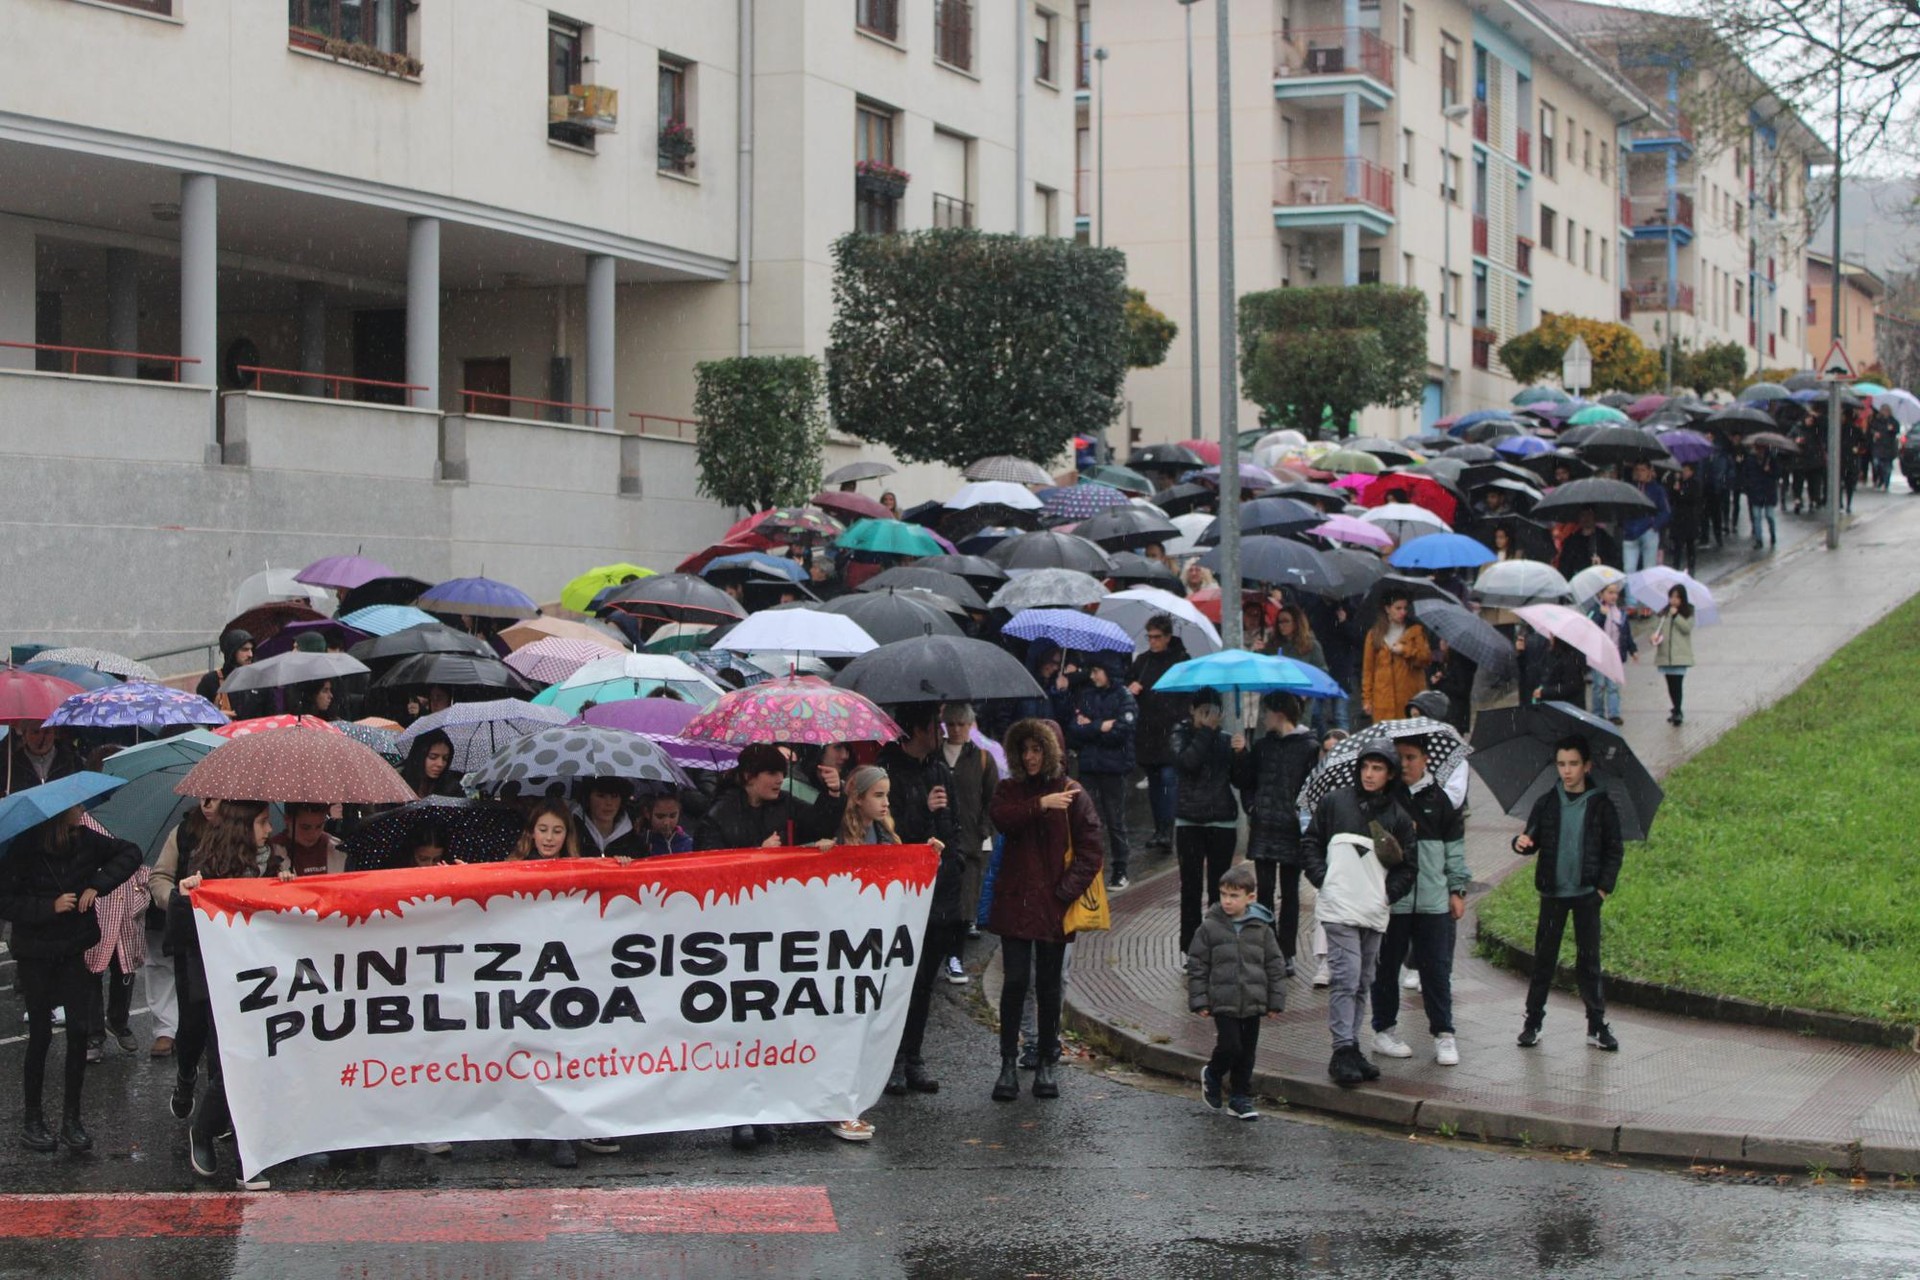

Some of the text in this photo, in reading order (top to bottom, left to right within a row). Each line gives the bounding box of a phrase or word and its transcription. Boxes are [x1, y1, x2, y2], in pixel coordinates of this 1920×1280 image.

[236, 924, 915, 1013] ZAINTZA SISTEMA
[265, 972, 888, 1058] PUBLIKOA ORAIN
[339, 1039, 818, 1089] #DerechoColectivoAlCuidado
